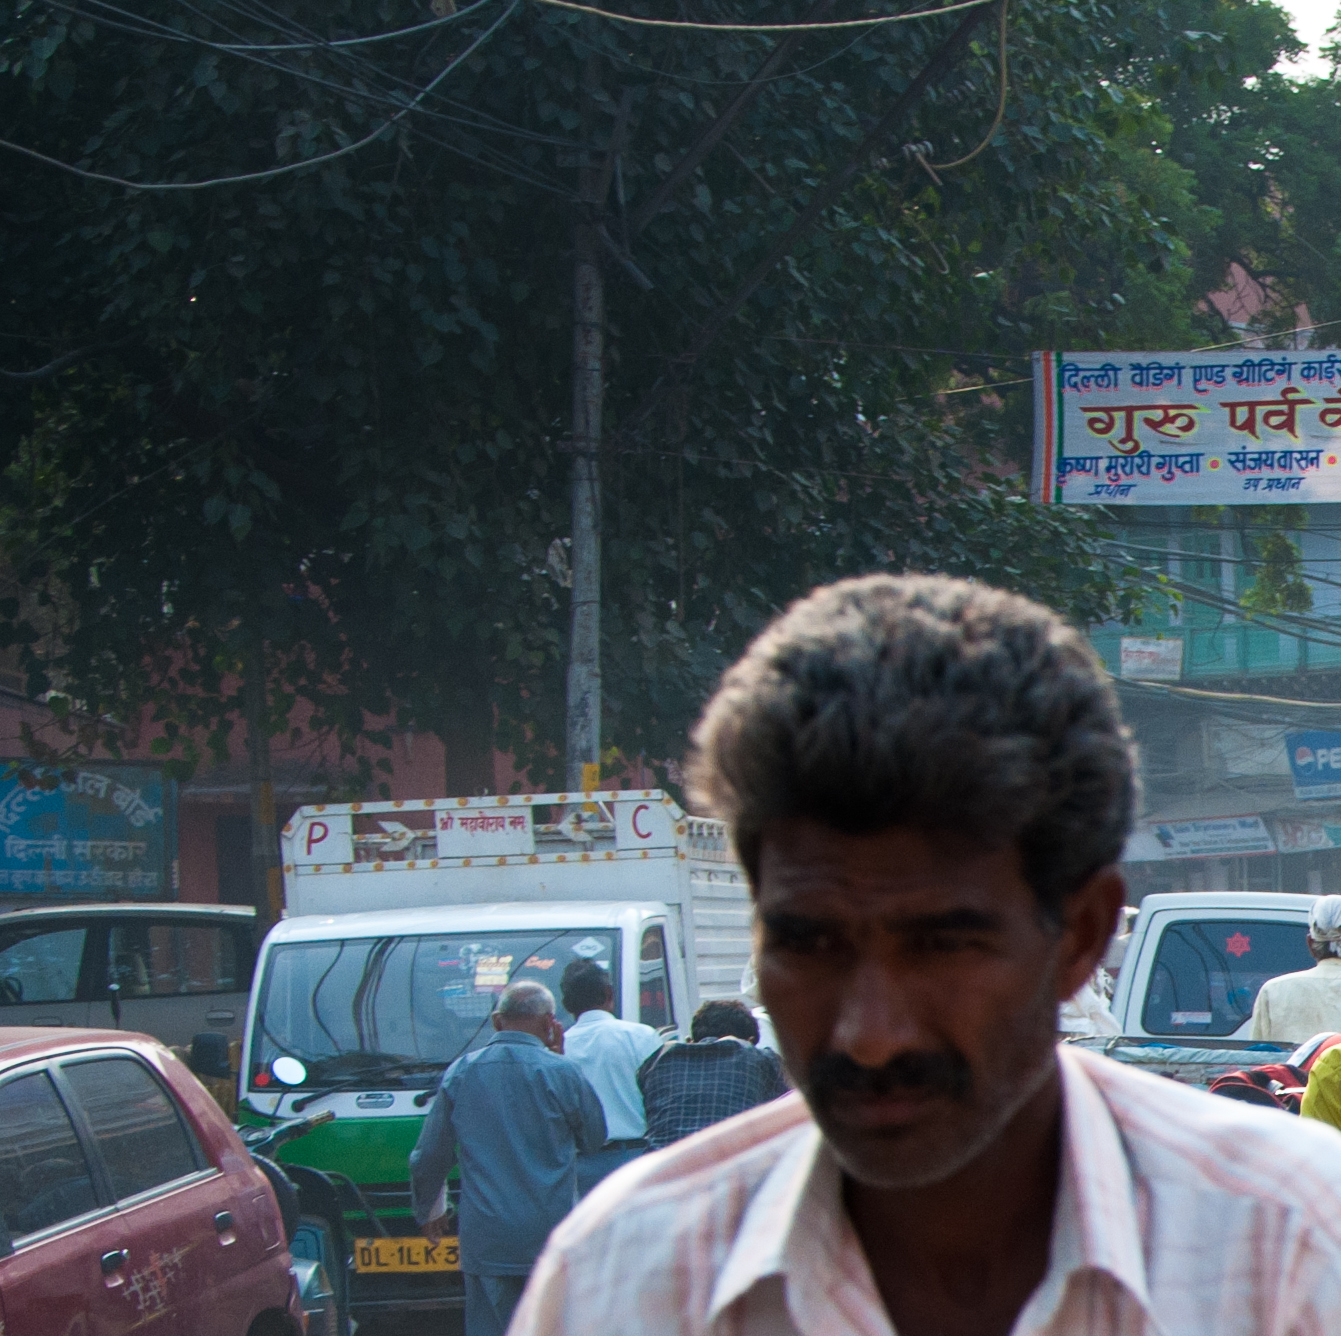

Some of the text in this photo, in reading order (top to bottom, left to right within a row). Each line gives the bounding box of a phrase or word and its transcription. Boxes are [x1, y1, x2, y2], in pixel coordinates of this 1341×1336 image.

[1059, 362, 1123, 392] दिल्ली
[1218, 386, 1317, 440] पर्व
[305, 820, 330, 856] P
[630, 803, 653, 840] C
[4, 833, 148, 863] दिल्ली सरकार
